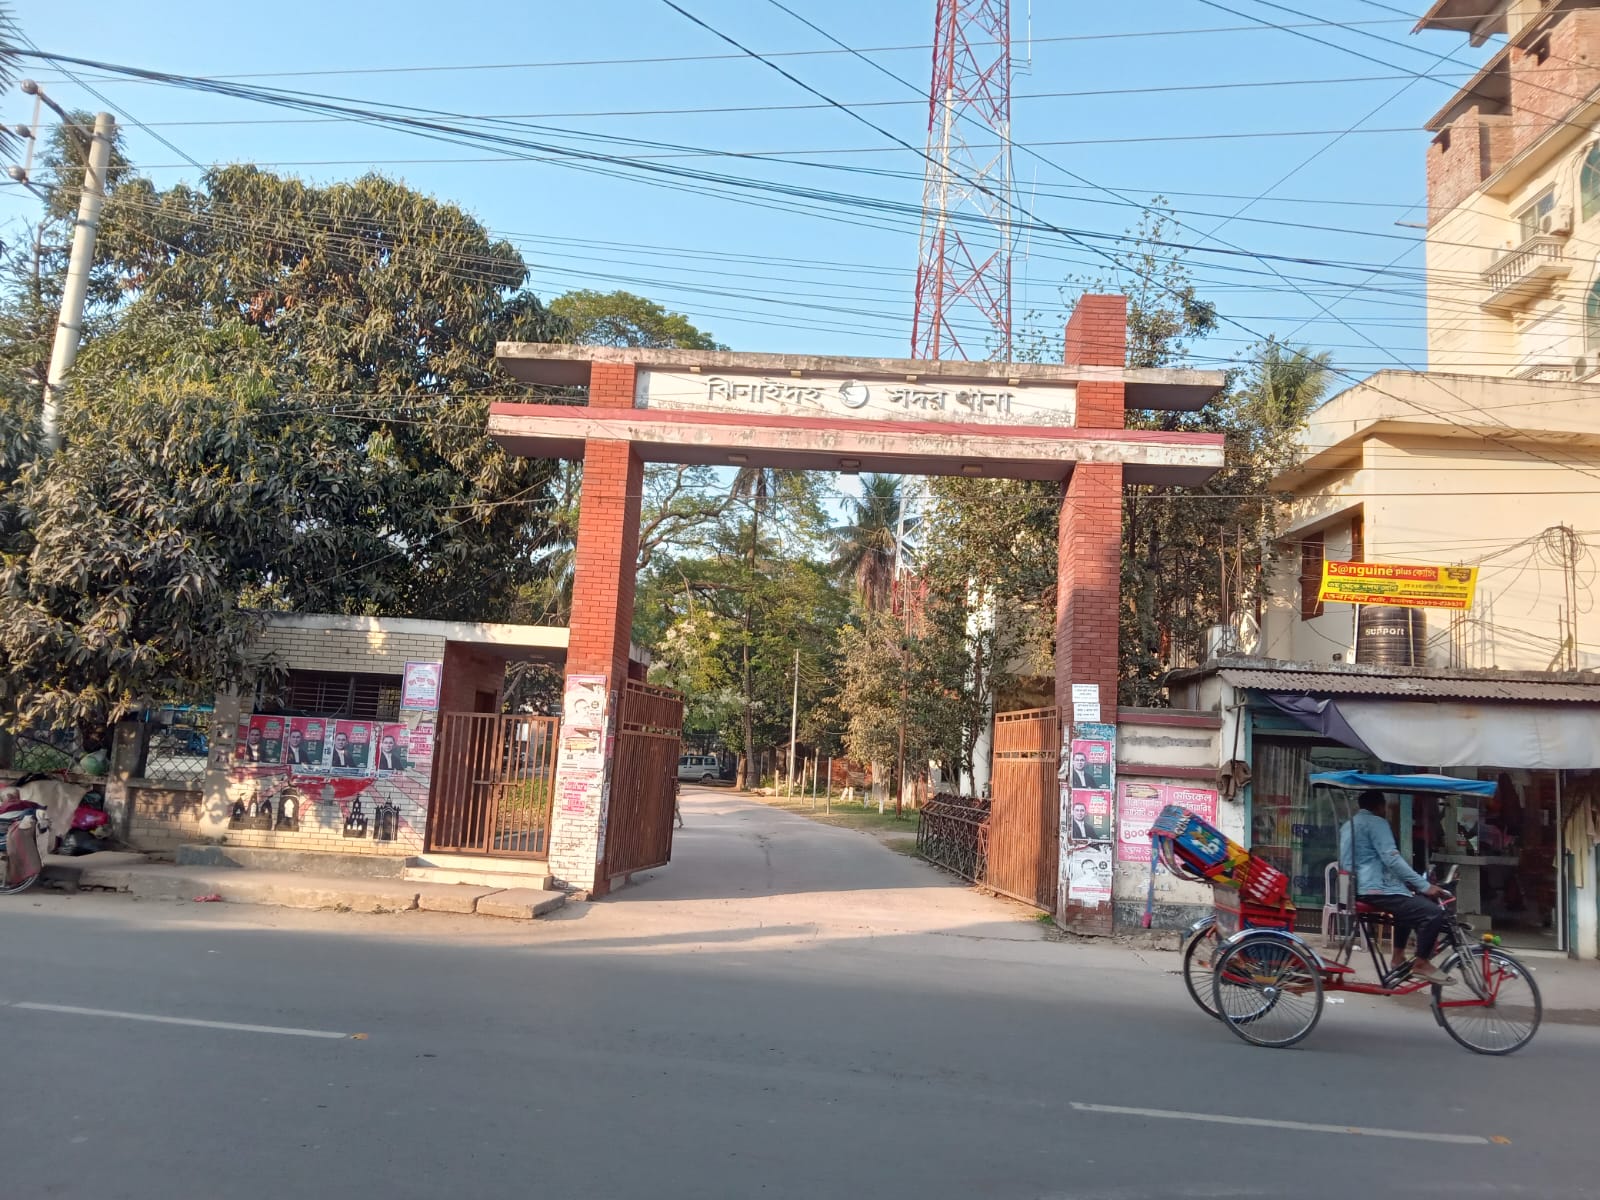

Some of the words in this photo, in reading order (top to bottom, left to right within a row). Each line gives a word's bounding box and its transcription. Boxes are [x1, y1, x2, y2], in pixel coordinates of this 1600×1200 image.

[706, 377, 825, 409] ঝিনাইদহ
[886, 387, 948, 411] সদর
[955, 388, 1015, 414] থানা
[1395, 568, 1413, 577] plus
[1173, 790, 1212, 802] মেডিকেল
